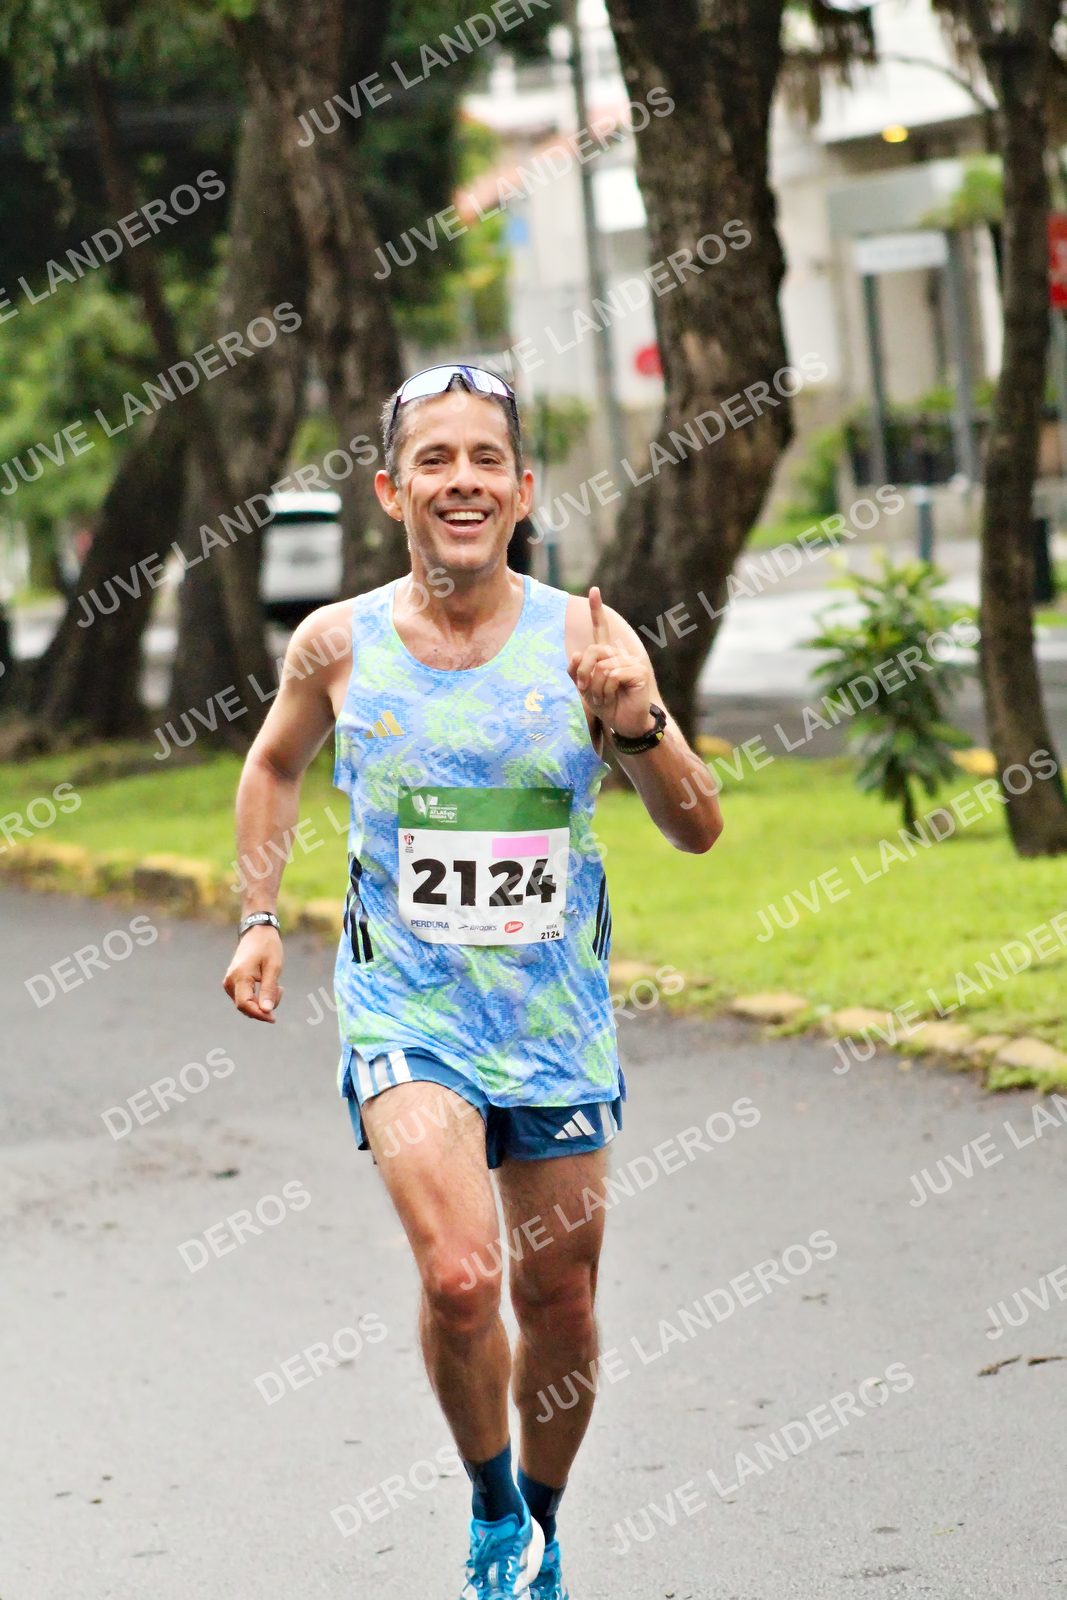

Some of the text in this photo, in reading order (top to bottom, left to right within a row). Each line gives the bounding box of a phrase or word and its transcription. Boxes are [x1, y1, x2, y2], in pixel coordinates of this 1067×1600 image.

[411, 858, 556, 906] 2124
[410, 919, 449, 929] PERDURA
[540, 930, 560, 940] 2124
